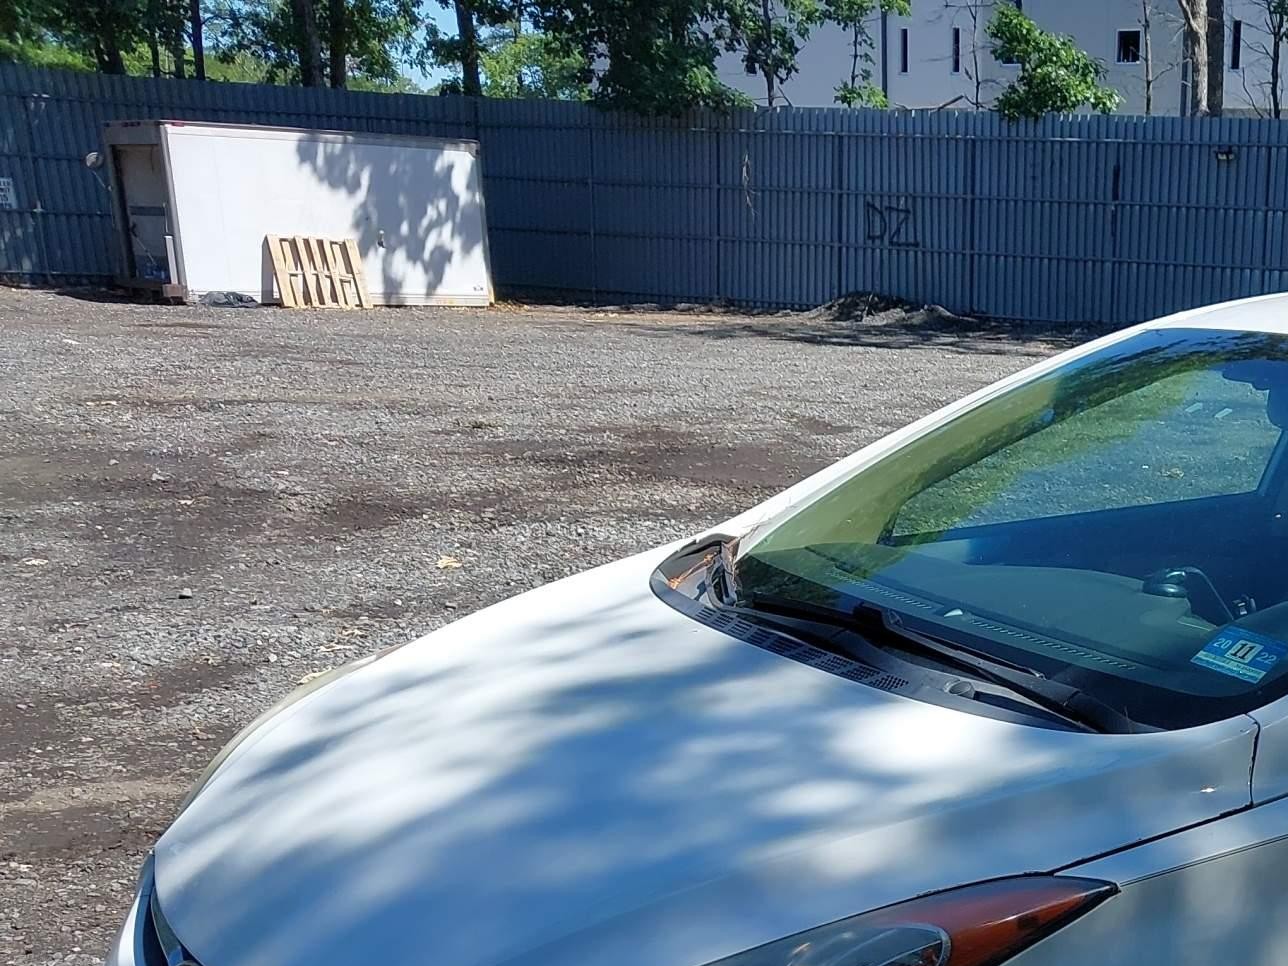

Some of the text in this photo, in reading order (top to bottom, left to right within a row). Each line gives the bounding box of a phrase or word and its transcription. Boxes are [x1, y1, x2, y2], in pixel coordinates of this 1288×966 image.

[866, 201, 920, 247] DZ
[1213, 637, 1233, 650] 20
[1230, 643, 1256, 660] 11
[1256, 651, 1277, 665] 22
